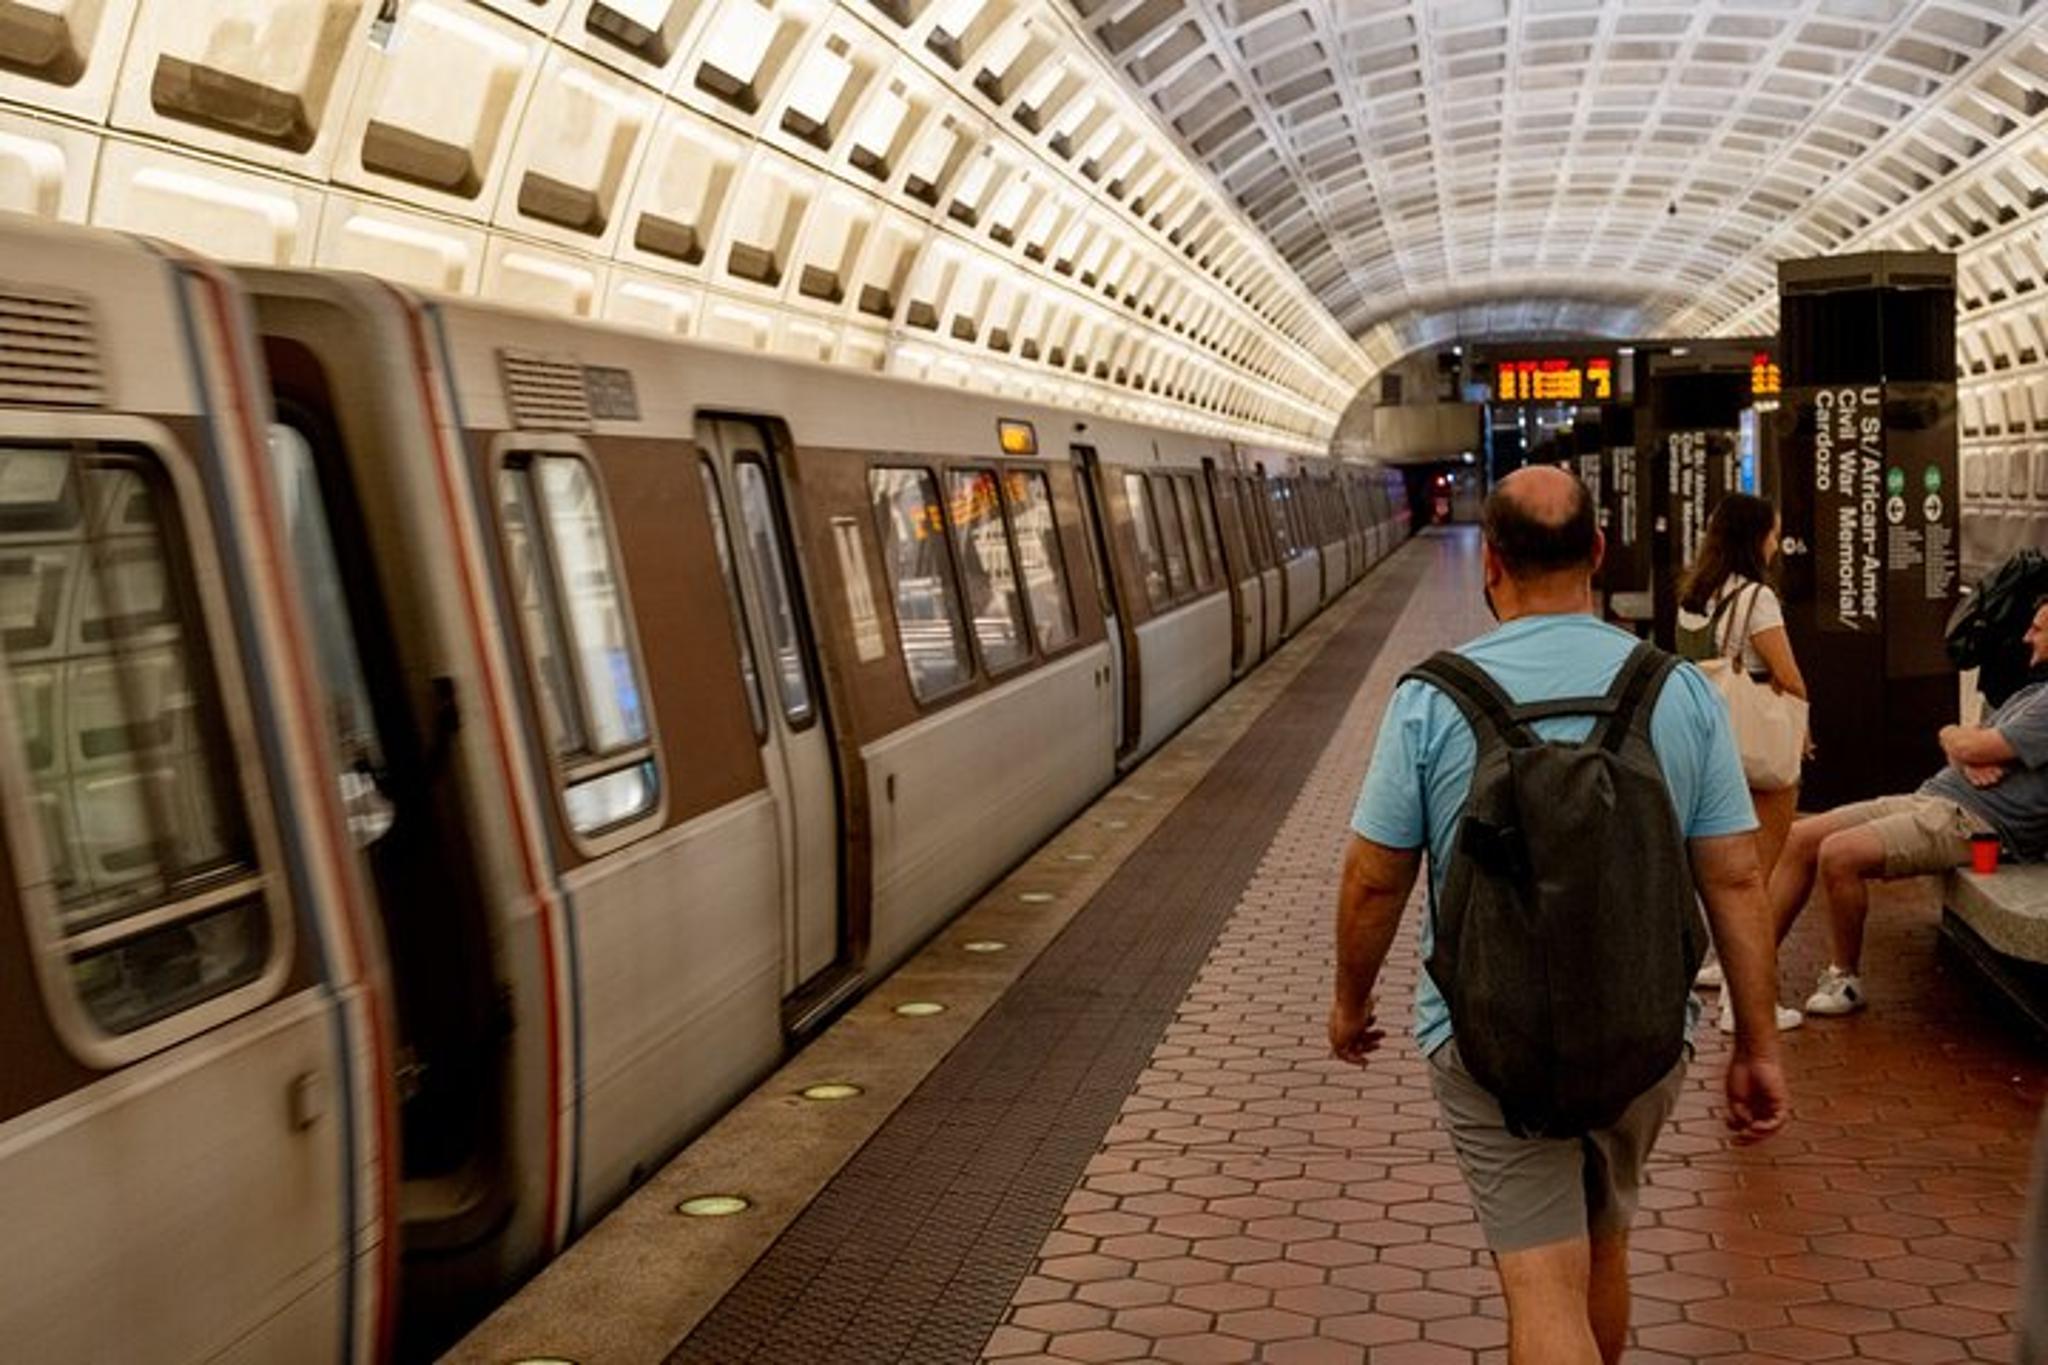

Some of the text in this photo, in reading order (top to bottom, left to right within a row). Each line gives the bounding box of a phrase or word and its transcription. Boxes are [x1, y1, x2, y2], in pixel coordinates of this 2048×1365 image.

[1816, 390, 1834, 490] Cardozo
[1838, 388, 1859, 629] Civil War Memorial/
[1861, 386, 1882, 619] U St/African-Amer
